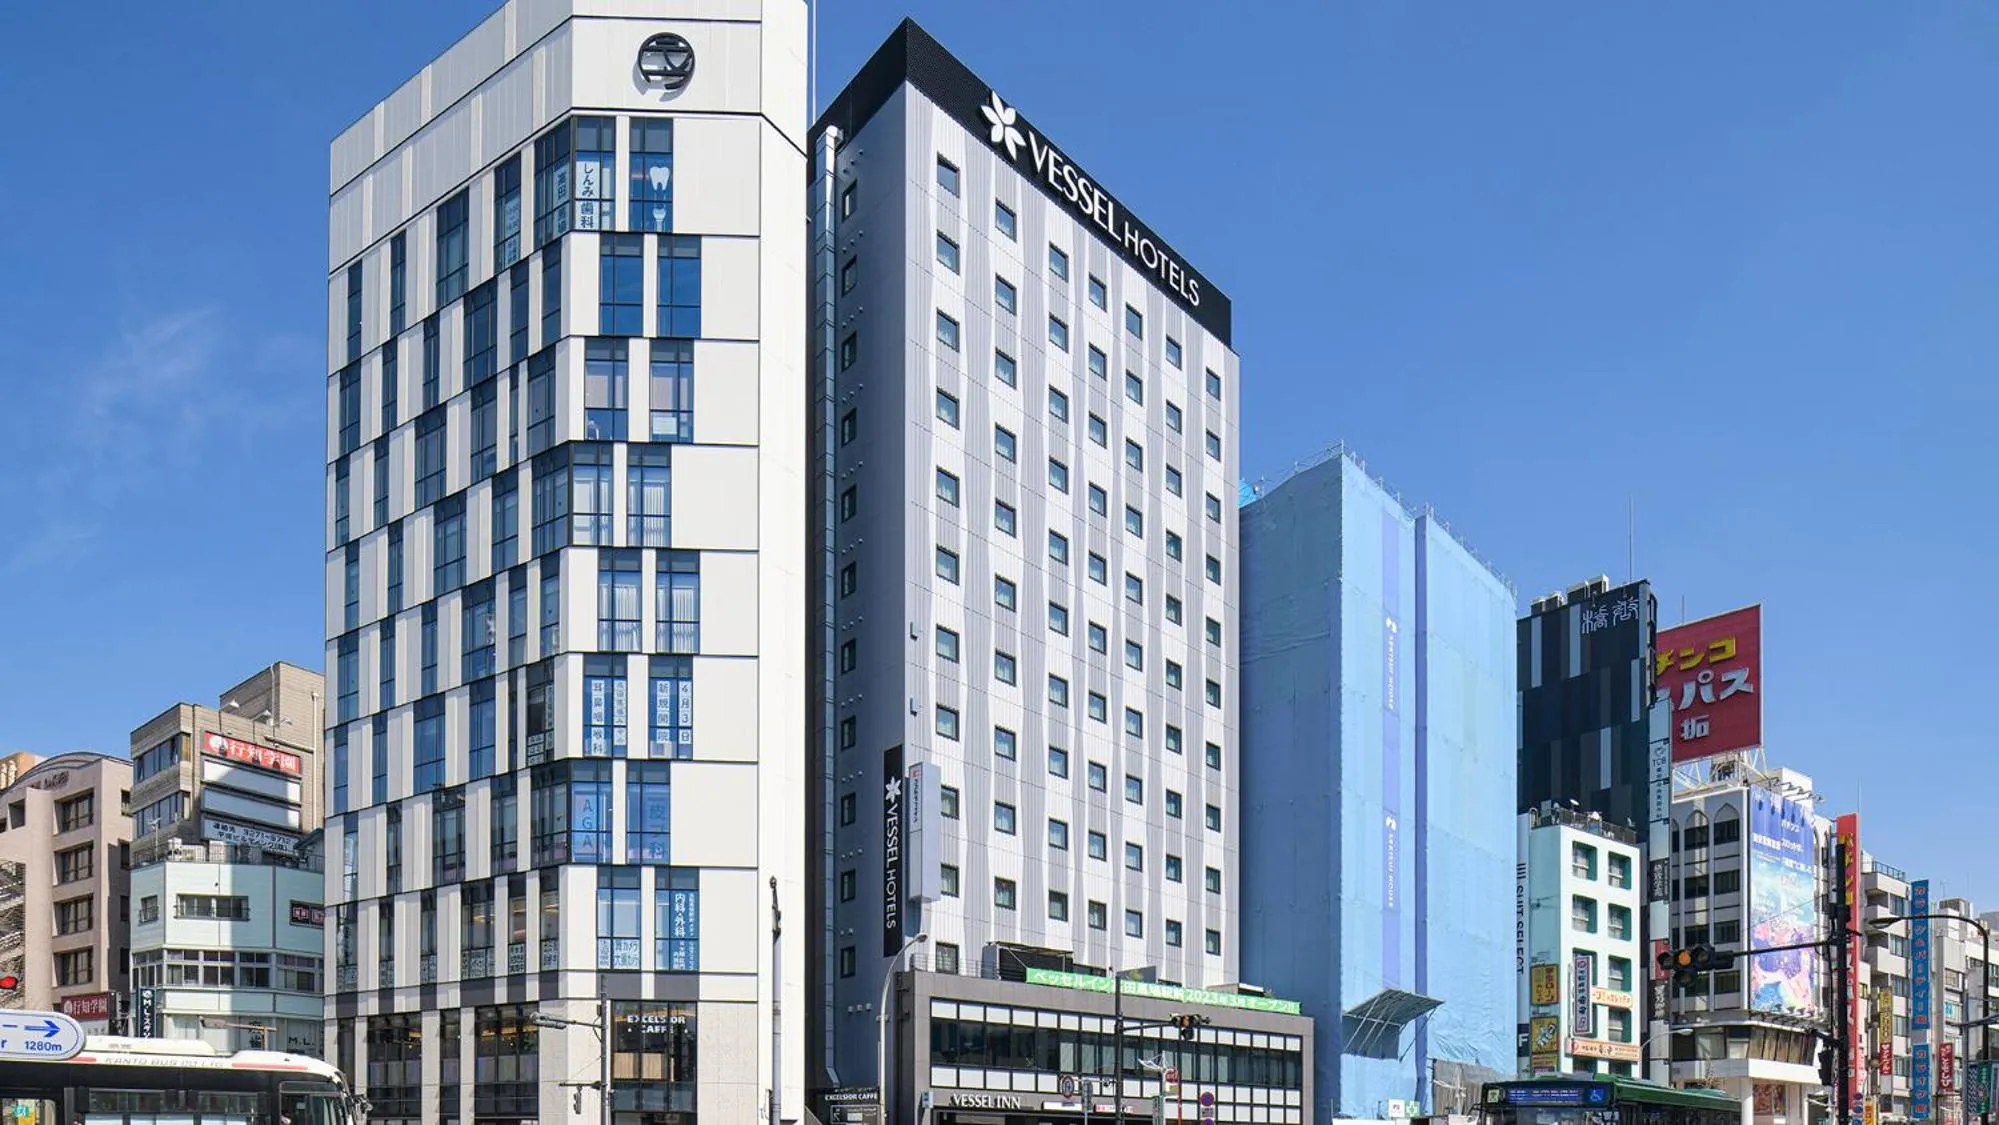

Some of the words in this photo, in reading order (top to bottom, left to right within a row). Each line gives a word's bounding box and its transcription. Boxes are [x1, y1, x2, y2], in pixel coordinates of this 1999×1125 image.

[581, 163, 594, 229] しんみ歯科
[1028, 130, 1122, 242] VESSEL
[1124, 221, 1200, 307] HOTELS
[680, 684, 690, 742] 4月3日
[228, 740, 298, 771] 行知学園
[582, 799, 593, 848] AGA
[886, 803, 898, 868] VESSEL
[886, 869, 897, 929] HOTELS
[627, 1015, 686, 1024] EXCELSOR
[25, 1040, 62, 1051] 1280m
[105, 1057, 148, 1065] KANTO
[953, 1093, 993, 1108] VESSEL
[996, 1095, 1021, 1110] INN
